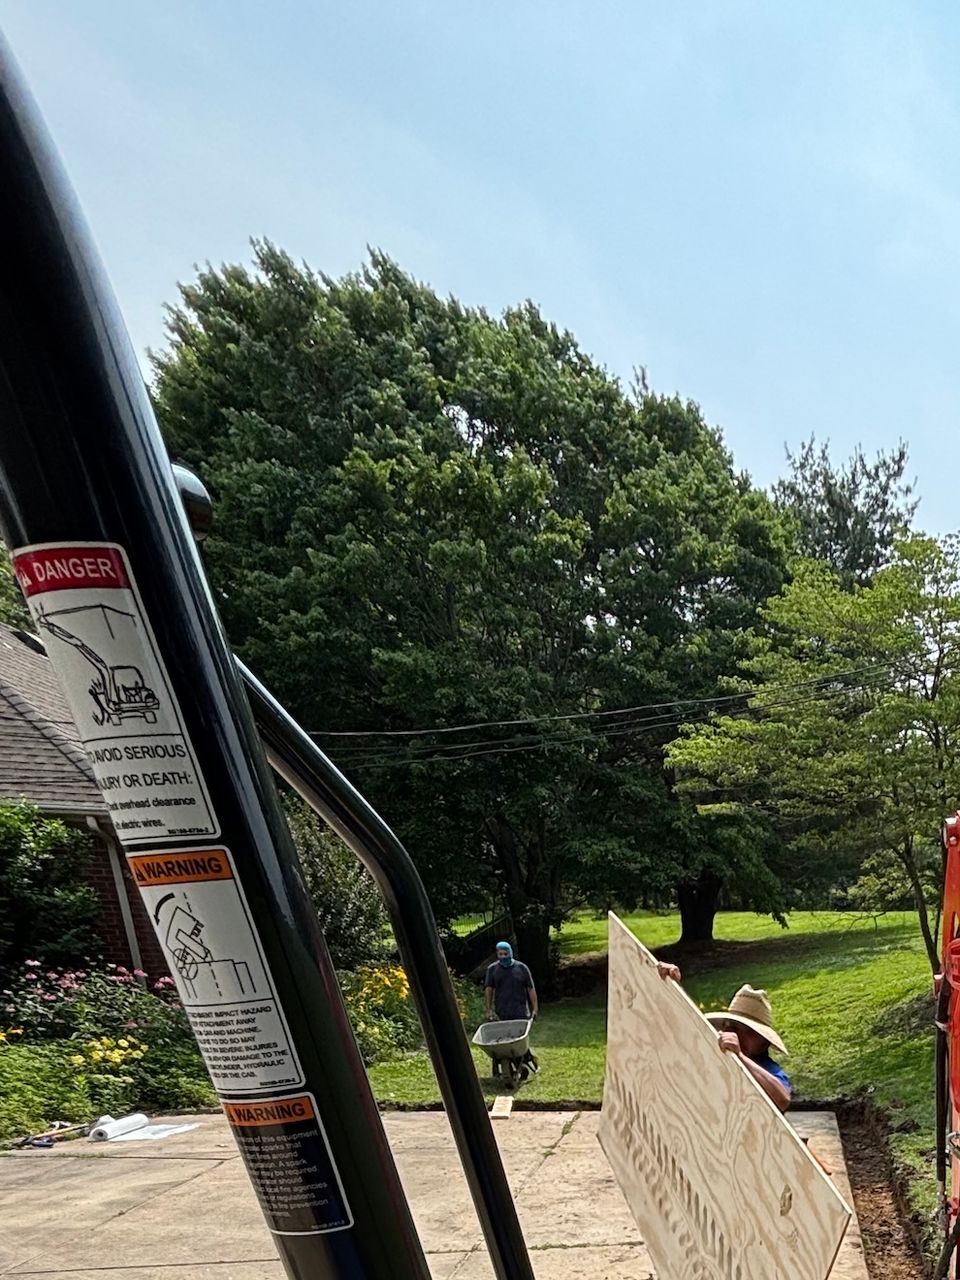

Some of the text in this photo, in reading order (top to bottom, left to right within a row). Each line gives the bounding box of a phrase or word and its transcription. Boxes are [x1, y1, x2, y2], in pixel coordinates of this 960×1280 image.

[33, 558, 117, 582] DANGER
[124, 744, 187, 760] SERIOUS
[122, 773, 142, 788] OR
[141, 771, 194, 787] DEATH:
[152, 796, 196, 807] clearance
[142, 857, 223, 879] WARNING
[240, 1005, 272, 1015] HAZARD
[261, 1051, 273, 1059] TO
[274, 1049, 289, 1057] THE
[234, 1103, 306, 1122] WARNING
[276, 1129, 318, 1143] equipment
